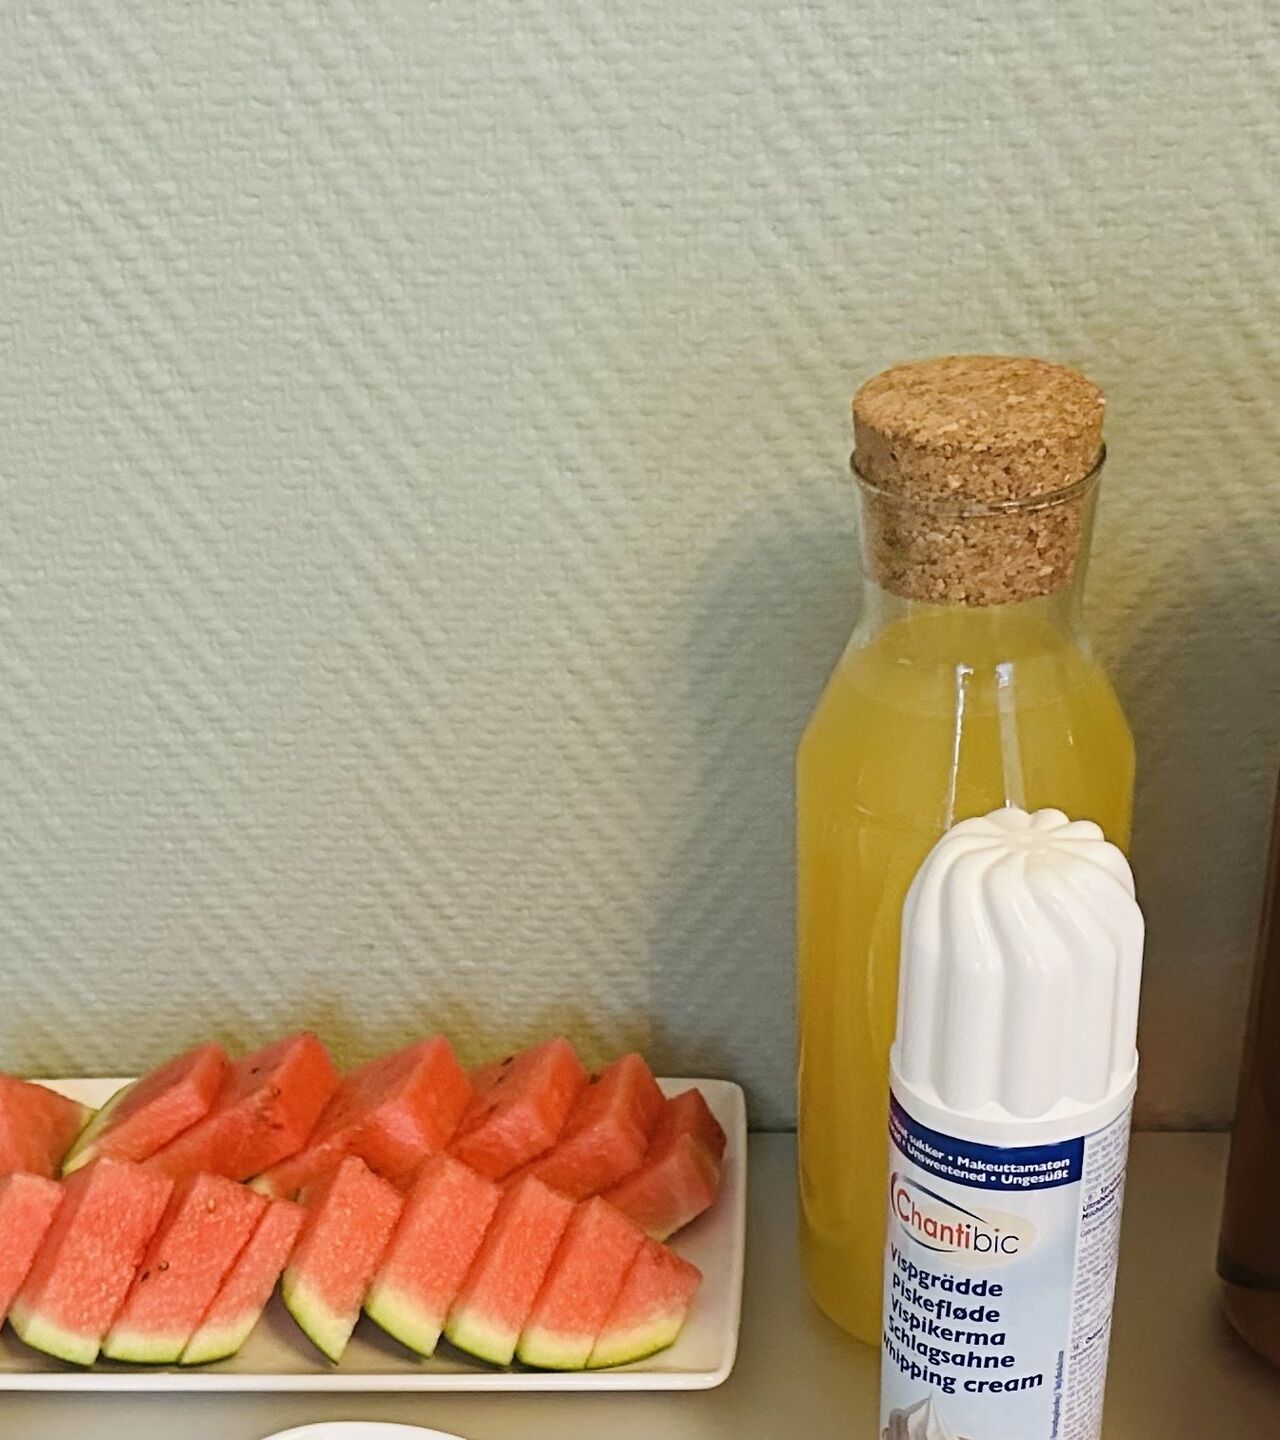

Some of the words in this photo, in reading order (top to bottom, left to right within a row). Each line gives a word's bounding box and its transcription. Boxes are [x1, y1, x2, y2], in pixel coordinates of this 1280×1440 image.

[906, 1143, 987, 1183] Unsweetened
[909, 1135, 945, 1160] sukker
[957, 1155, 1071, 1175] Makeuttamaton
[895, 1188, 1021, 1255] Chantibic
[891, 1241, 1004, 1297] Vispgrädde
[891, 1293, 1006, 1347] Vispikerma
[892, 1271, 1001, 1323] Piskefløde
[888, 1314, 1016, 1369] Schlagsahne
[963, 1373, 1043, 1394] cream
